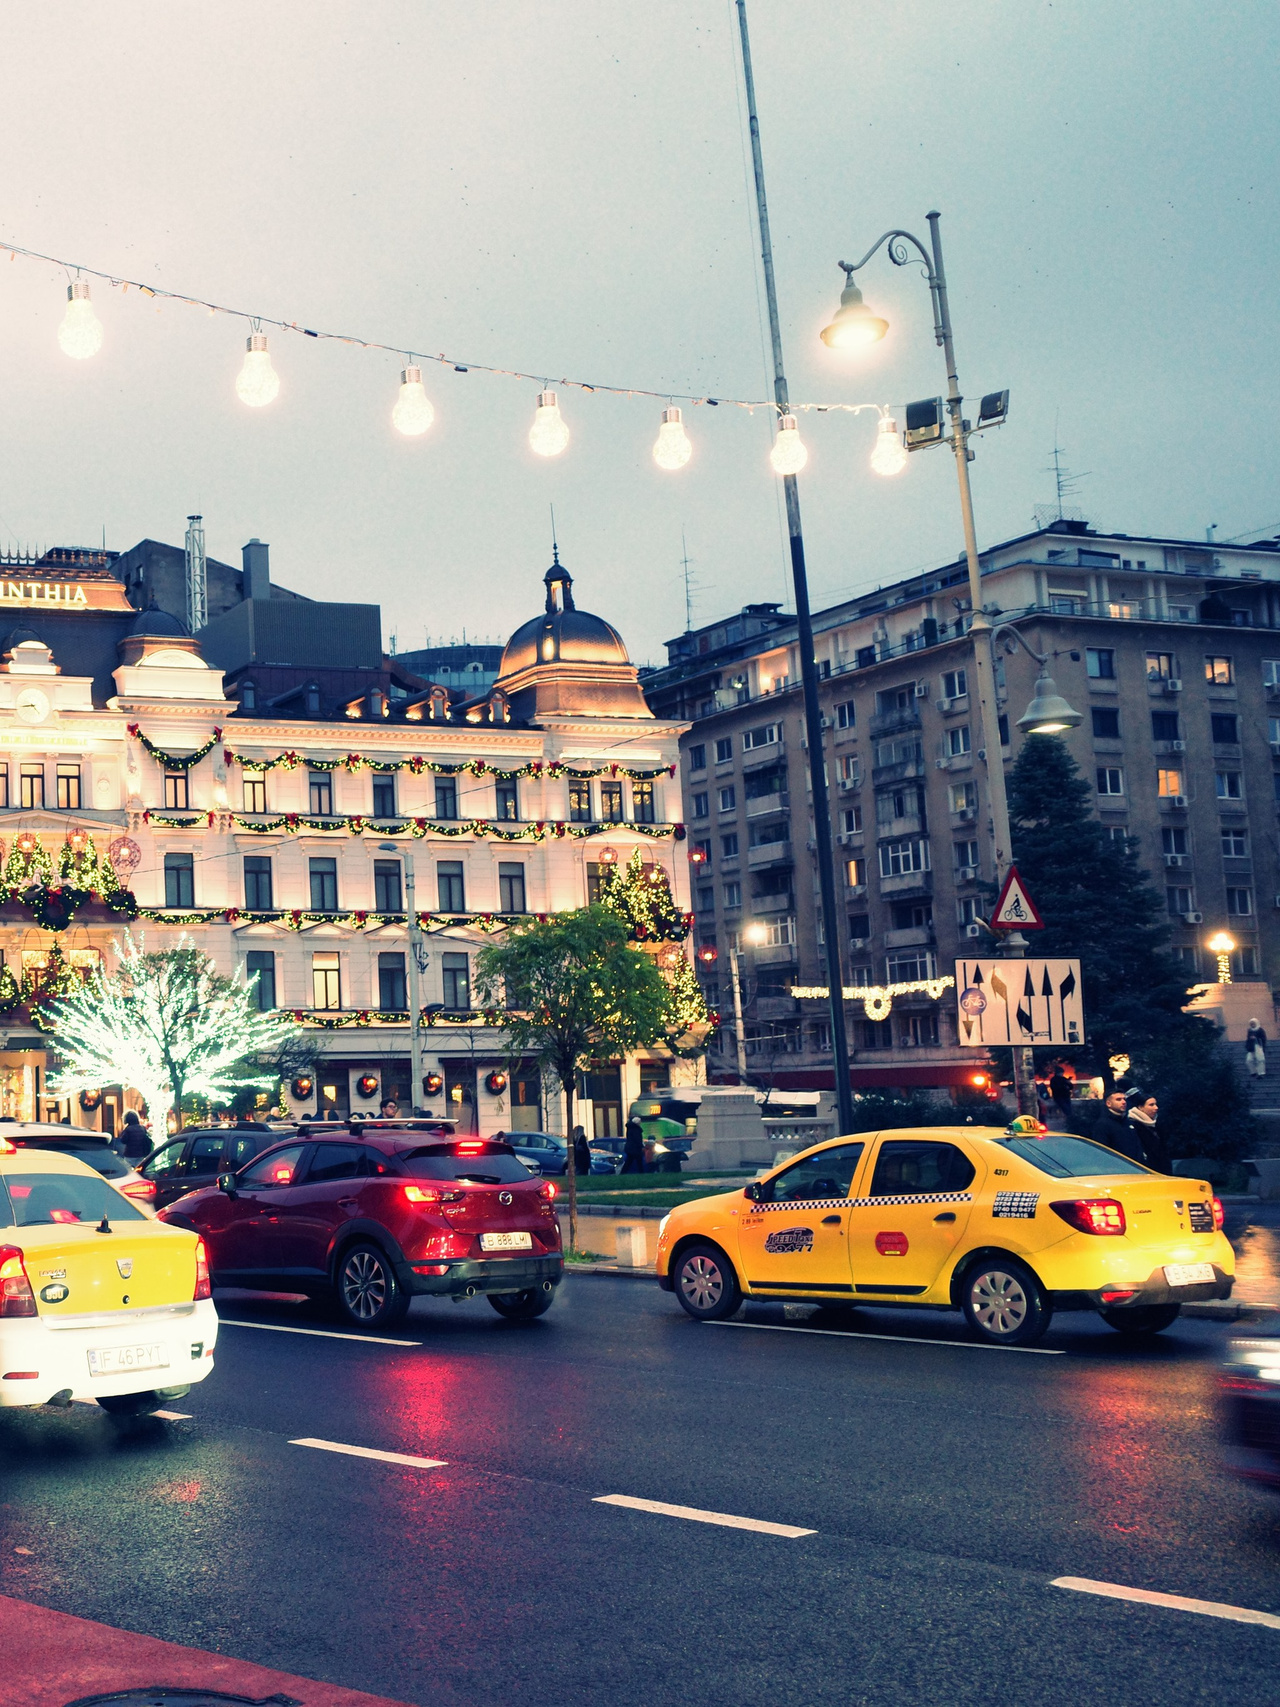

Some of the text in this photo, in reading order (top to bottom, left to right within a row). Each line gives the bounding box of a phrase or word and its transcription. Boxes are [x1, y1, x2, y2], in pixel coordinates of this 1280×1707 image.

[487, 1235, 494, 1246] B
[497, 1234, 513, 1245] 888
[100, 1351, 111, 1368] IF
[118, 1349, 133, 1365] 46
